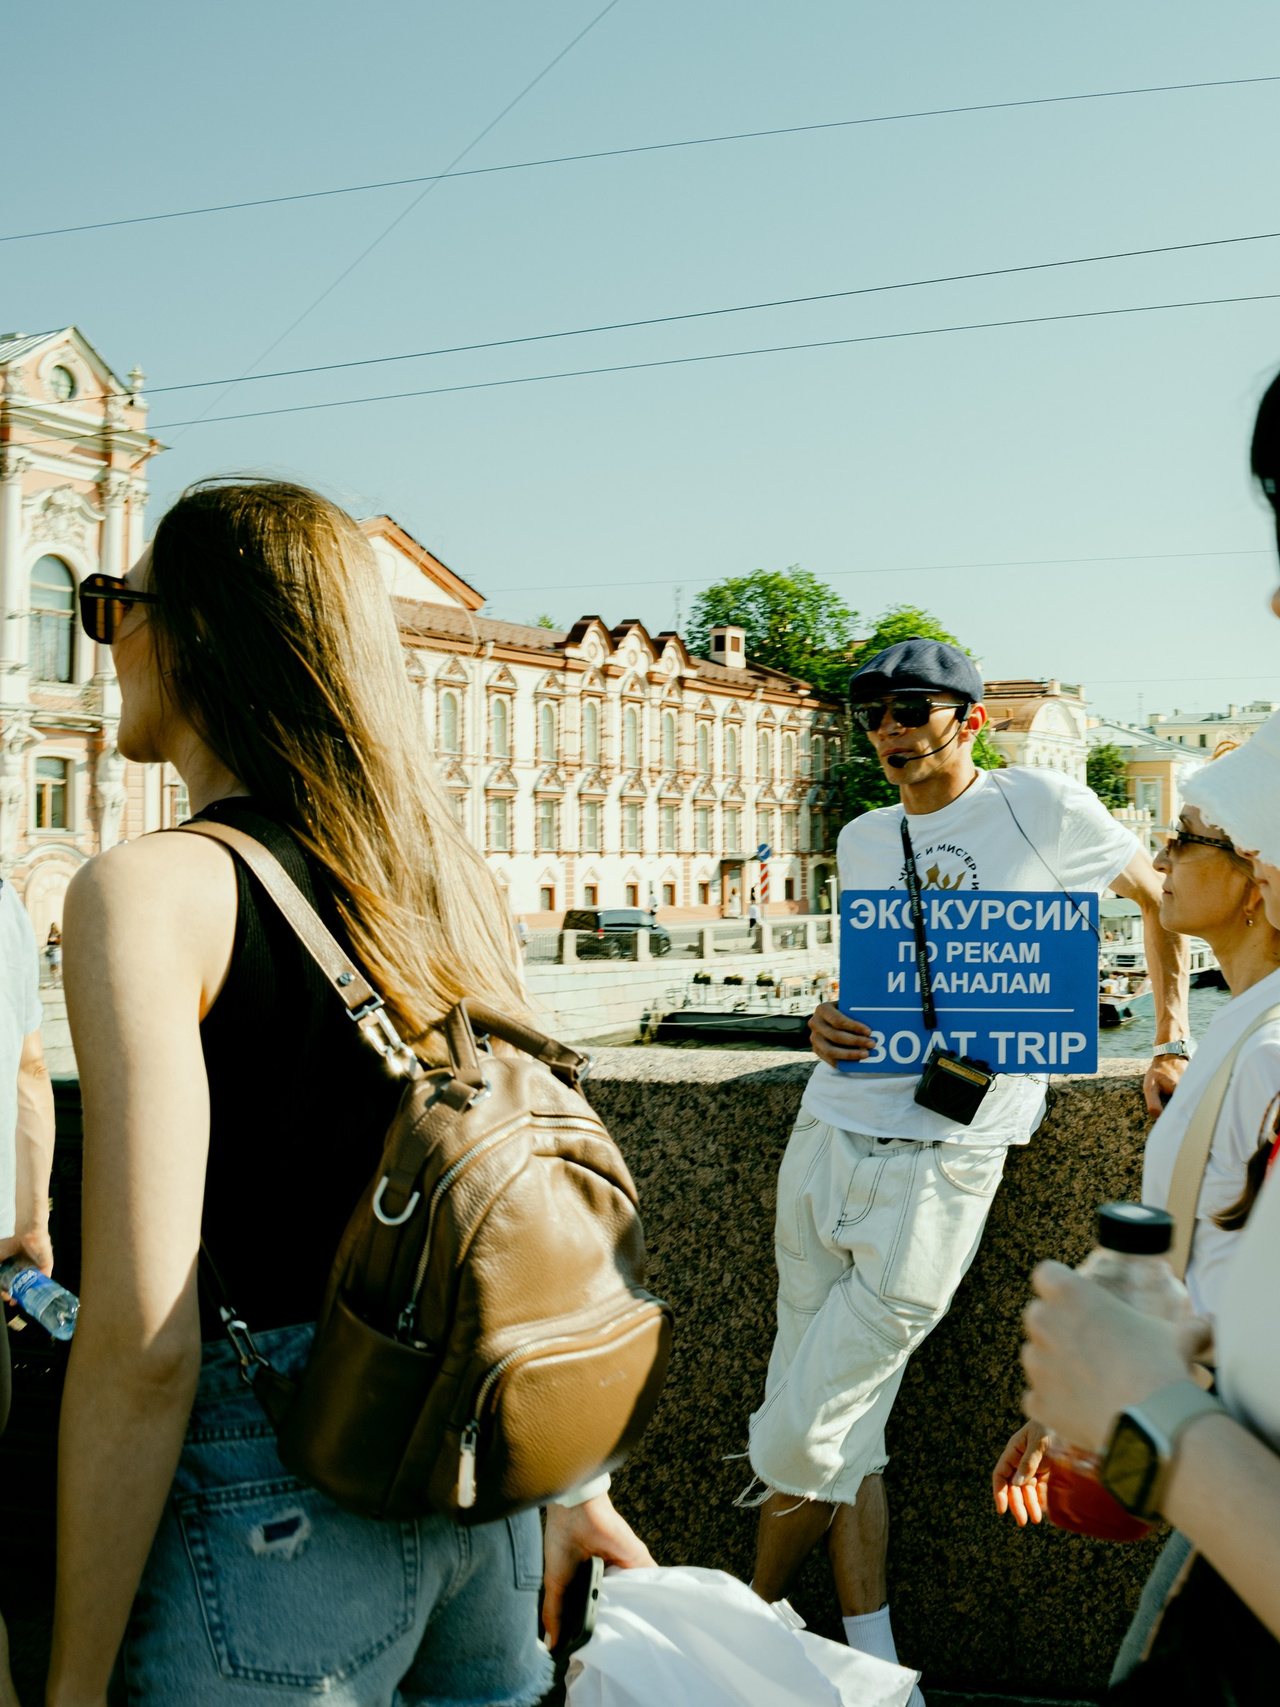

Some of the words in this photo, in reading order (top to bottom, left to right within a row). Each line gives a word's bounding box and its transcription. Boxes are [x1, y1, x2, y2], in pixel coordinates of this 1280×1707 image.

[925, 847, 933, 856] И
[936, 843, 978, 871] МИСТЕР
[849, 898, 1090, 931] ЭКСКУРСИИ
[912, 896, 921, 917] Heard
[946, 942, 1040, 963] РЕКАМ
[887, 971, 905, 993] И
[859, 1030, 977, 1064] BOAT
[989, 1031, 1087, 1065] TRIP
